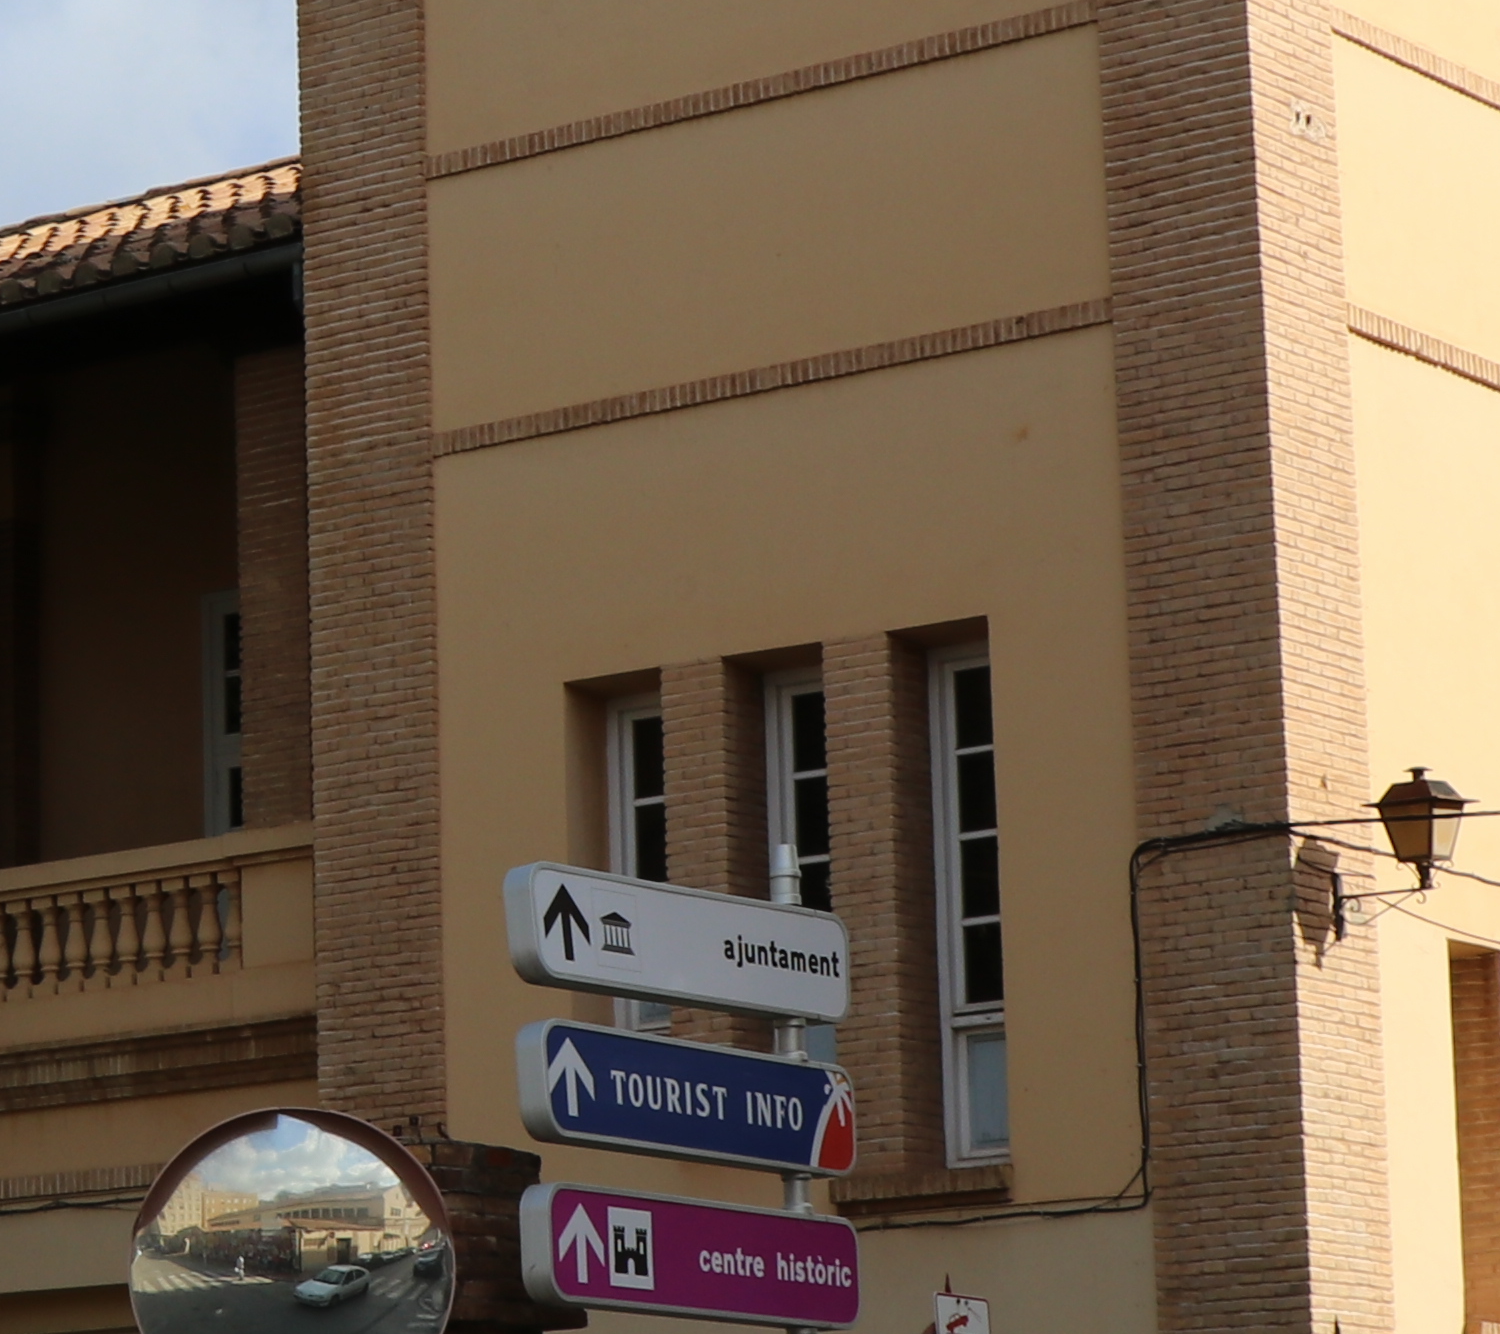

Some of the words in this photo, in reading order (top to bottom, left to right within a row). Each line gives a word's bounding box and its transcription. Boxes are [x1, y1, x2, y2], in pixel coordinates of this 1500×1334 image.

[723, 934, 841, 978] ajuntament
[610, 1069, 728, 1121] TOURIST
[746, 1091, 803, 1131] INFO
[699, 1247, 765, 1278] centre
[776, 1252, 852, 1288] històric
